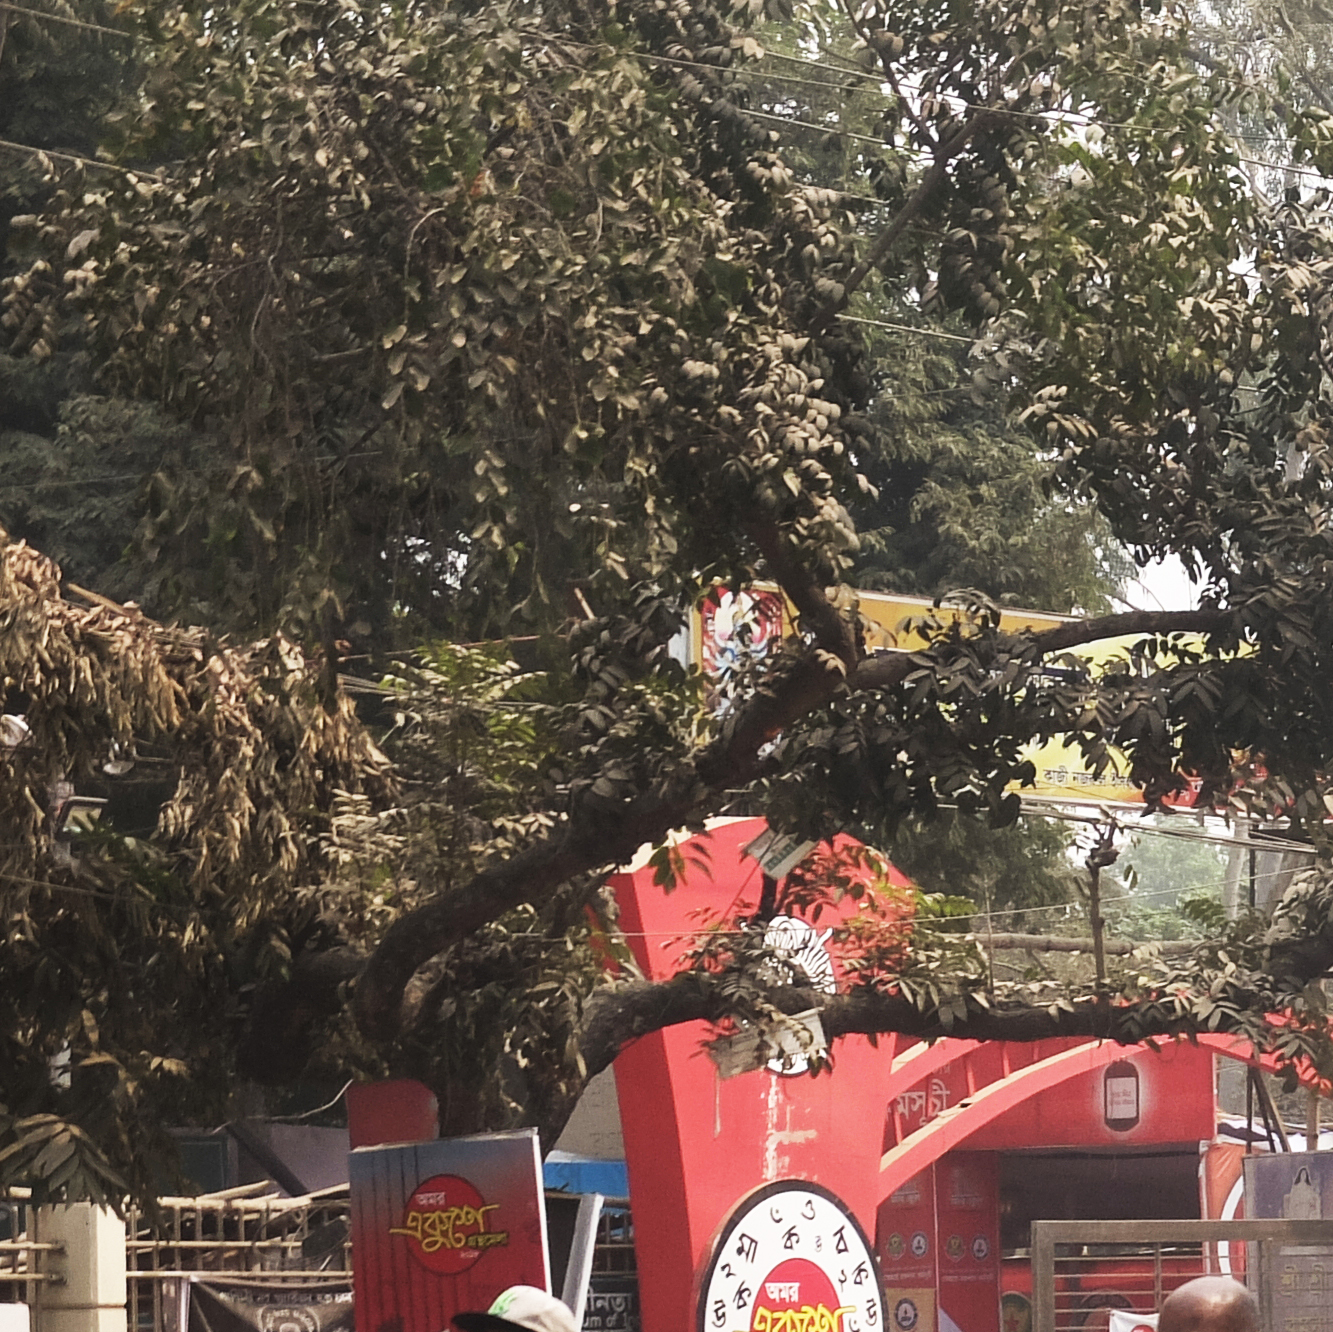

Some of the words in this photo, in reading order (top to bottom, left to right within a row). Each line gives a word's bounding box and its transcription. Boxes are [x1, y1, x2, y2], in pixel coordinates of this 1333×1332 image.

[887, 1078, 951, 1126] মসূচী
[416, 1191, 446, 1207] অমর
[389, 1204, 500, 1252] একুশে
[765, 1282, 800, 1303] অমর
